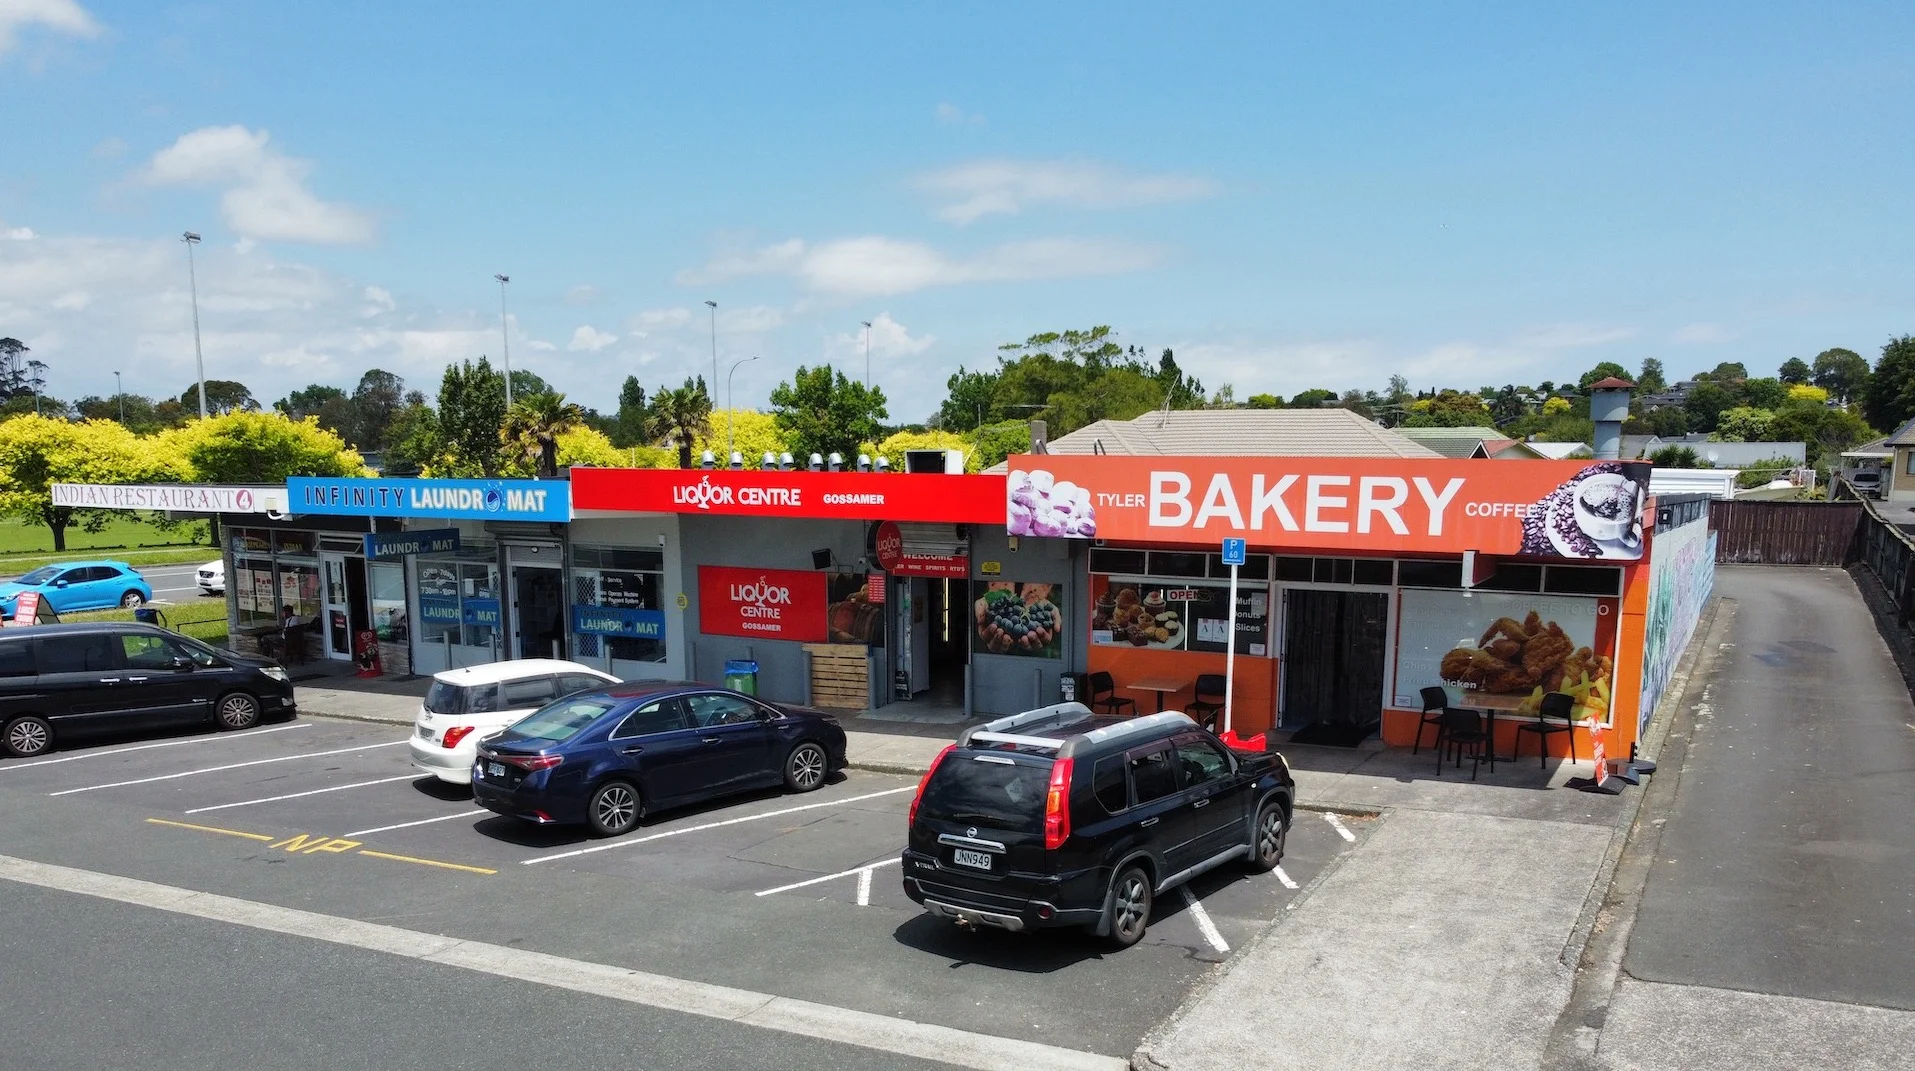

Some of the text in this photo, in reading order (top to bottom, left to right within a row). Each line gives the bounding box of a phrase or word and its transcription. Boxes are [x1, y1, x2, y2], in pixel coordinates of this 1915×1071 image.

[54, 485, 109, 504] INDIAN
[114, 487, 235, 509] RESTAURANT
[304, 485, 404, 508] INFINITY
[673, 478, 884, 509] LIQUOR CENTRE GOSSAMER
[1097, 471, 1537, 536] TYLER BAKERY COFFEE
[1230, 540, 1238, 550] P
[1229, 551, 1238, 559] 60
[731, 580, 792, 607] LIQUOR
[740, 606, 781, 619] CENTRE
[1236, 611, 1261, 619] onuts
[742, 621, 781, 632] GOSSAMER
[1201, 624, 1208, 633] A
[1217, 625, 1224, 634] A
[1235, 622, 1260, 632] Slices
[268, 834, 362, 853] NP
[955, 850, 990, 868] JNN949
